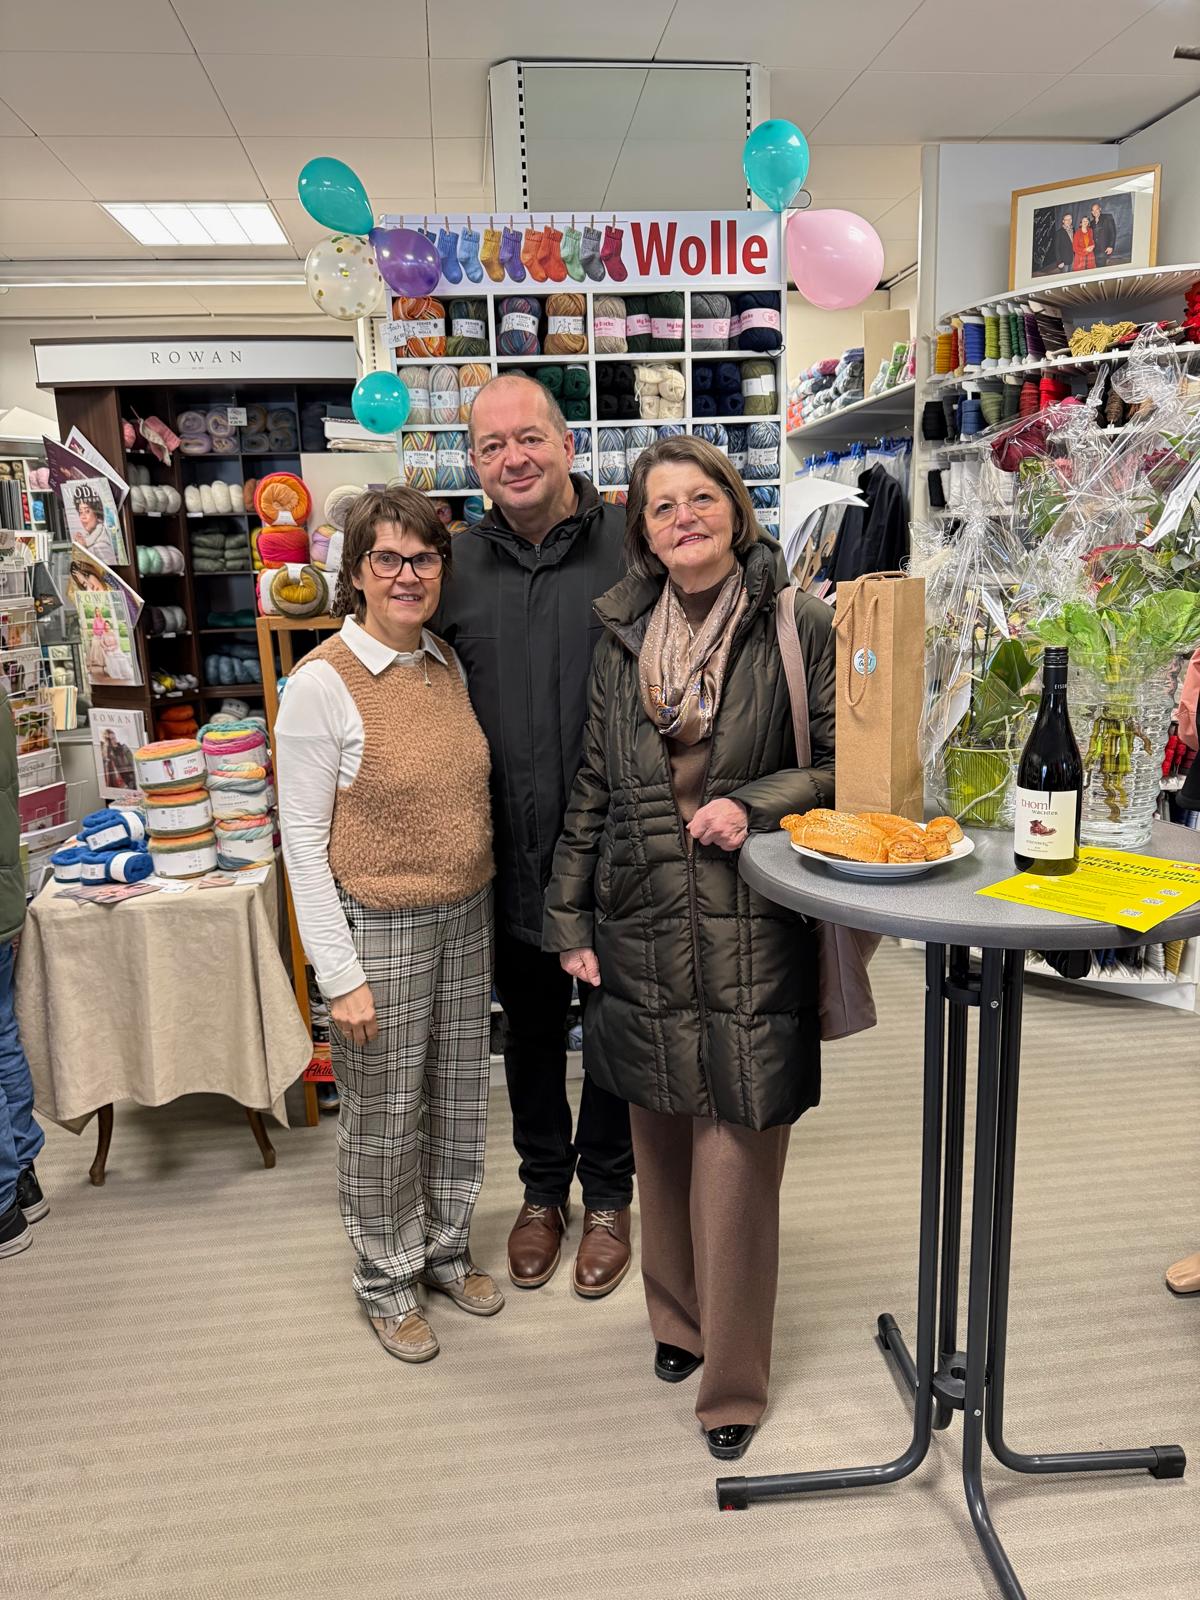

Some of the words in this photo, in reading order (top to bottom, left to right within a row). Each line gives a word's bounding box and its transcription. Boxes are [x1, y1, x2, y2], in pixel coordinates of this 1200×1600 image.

[630, 219, 768, 276] Wolle
[150, 351, 243, 364] ROWAN
[92, 713, 131, 724] ROWAN
[1163, 870, 1196, 878] UND
